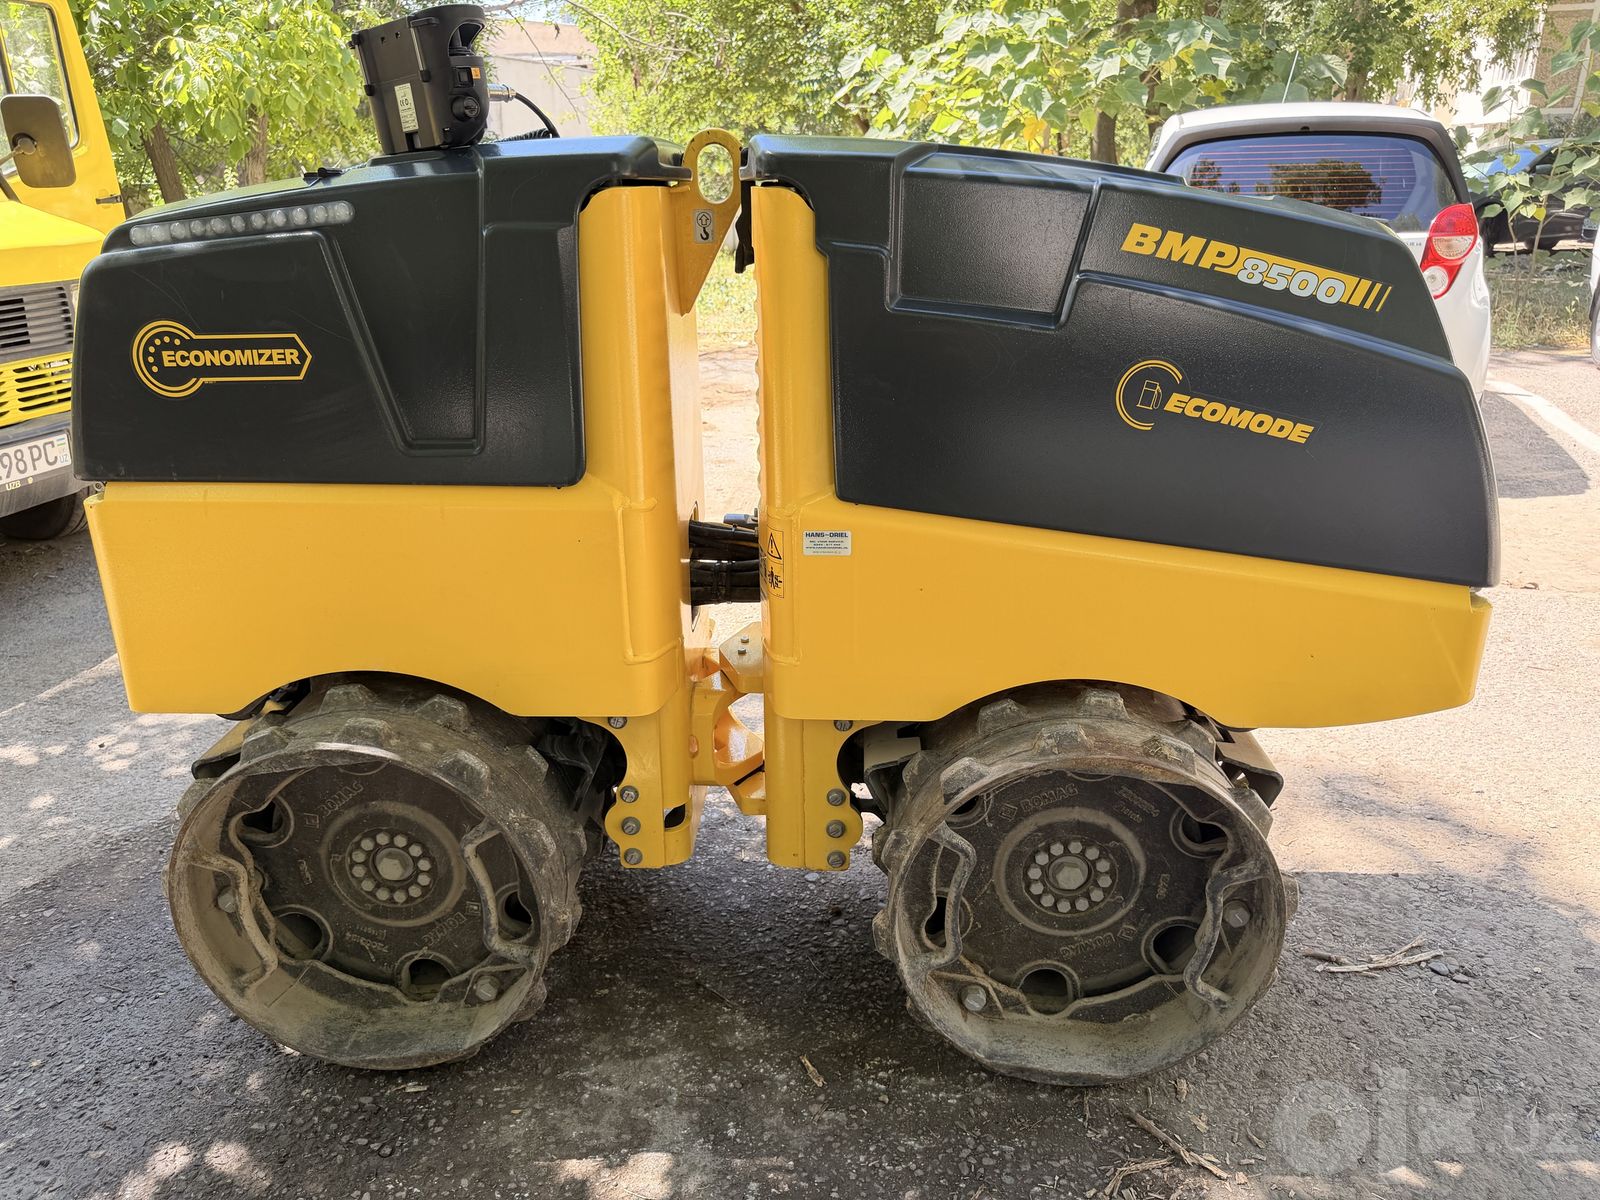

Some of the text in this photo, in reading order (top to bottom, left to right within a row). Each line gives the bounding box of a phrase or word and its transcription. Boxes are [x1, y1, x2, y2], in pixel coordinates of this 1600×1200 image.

[161, 348, 301, 367] ECONOMIZER
[1163, 392, 1315, 444] ECOMODE
[0, 440, 58, 479] 98PC
[6, 480, 21, 490] UZB
[1020, 783, 1079, 813] BOMAG
